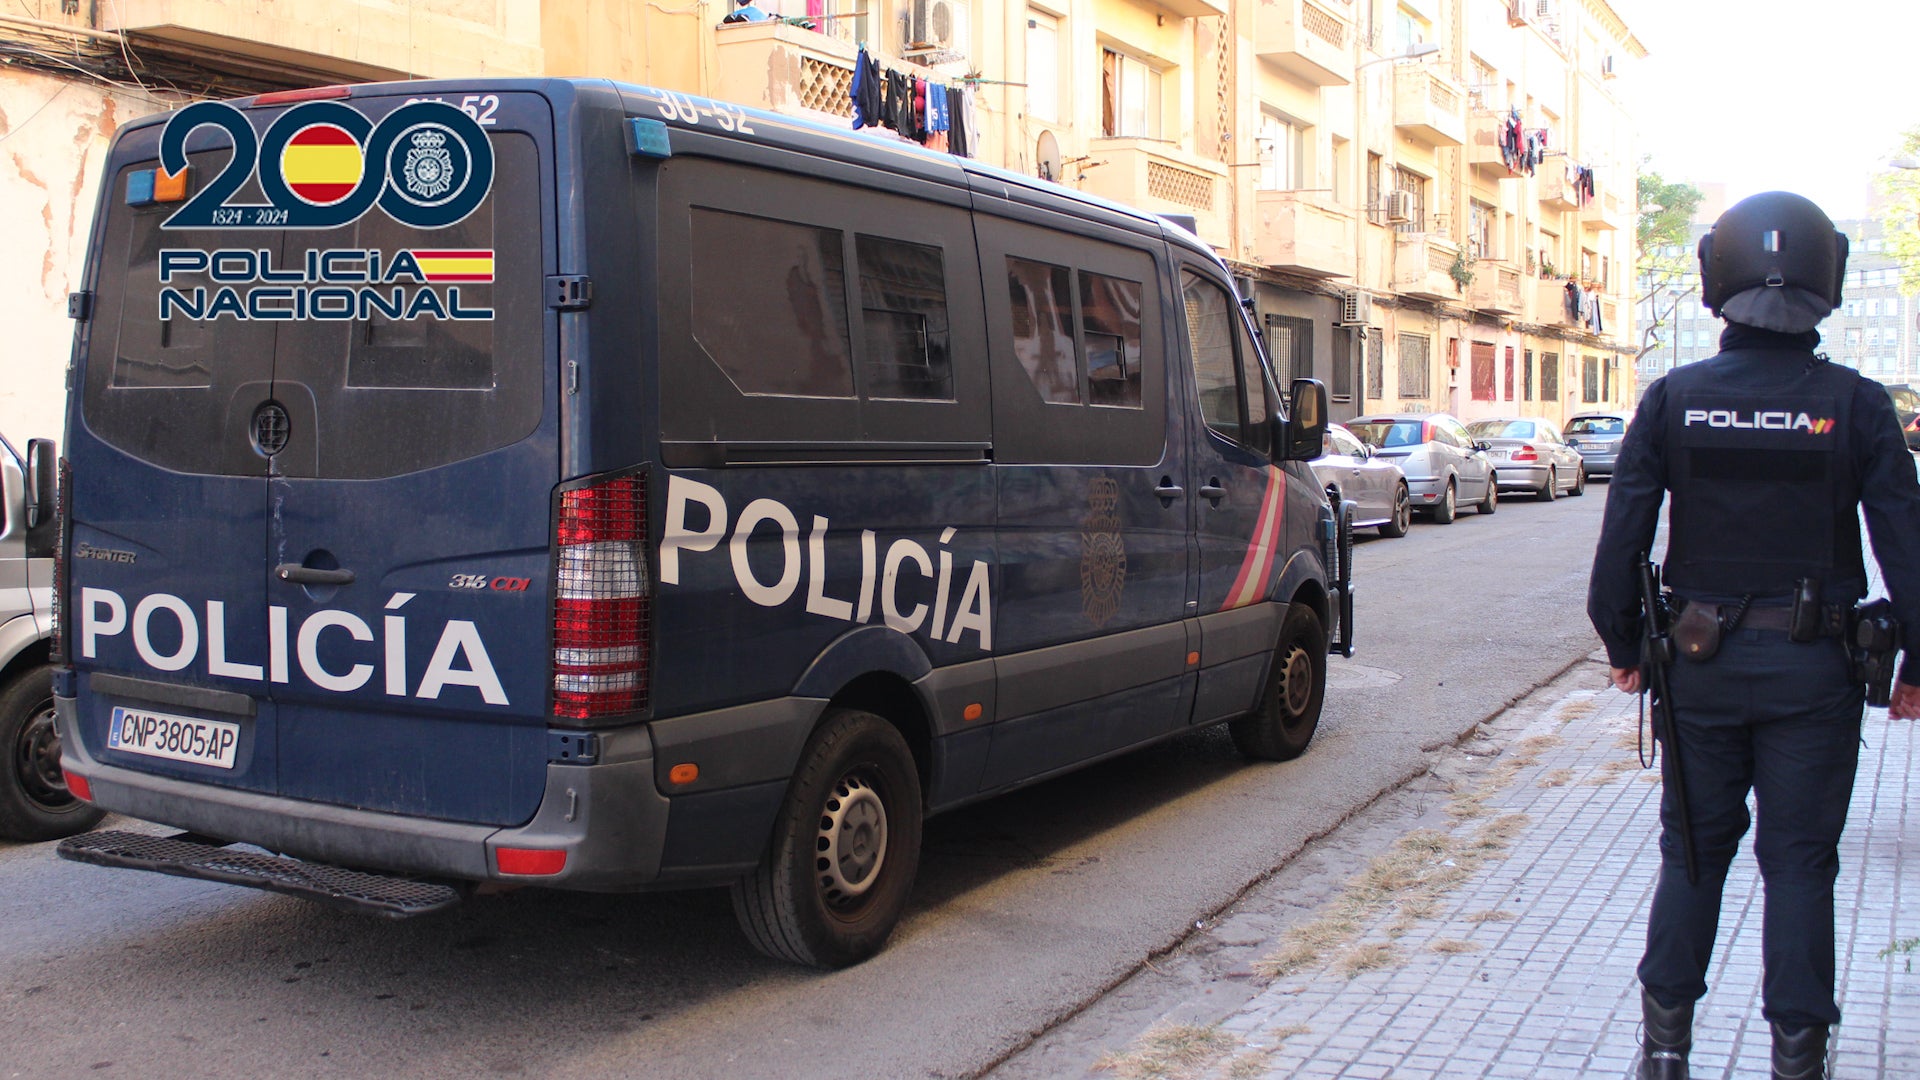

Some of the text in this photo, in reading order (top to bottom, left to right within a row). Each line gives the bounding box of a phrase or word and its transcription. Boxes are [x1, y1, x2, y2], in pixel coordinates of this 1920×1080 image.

[1684, 409, 1815, 430] POLICIA
[448, 574, 532, 592] 316 CDI
[659, 474, 992, 651] POLICÍA
[82, 586, 510, 706] POLICÍA
[121, 714, 234, 760] CNP3805AP
